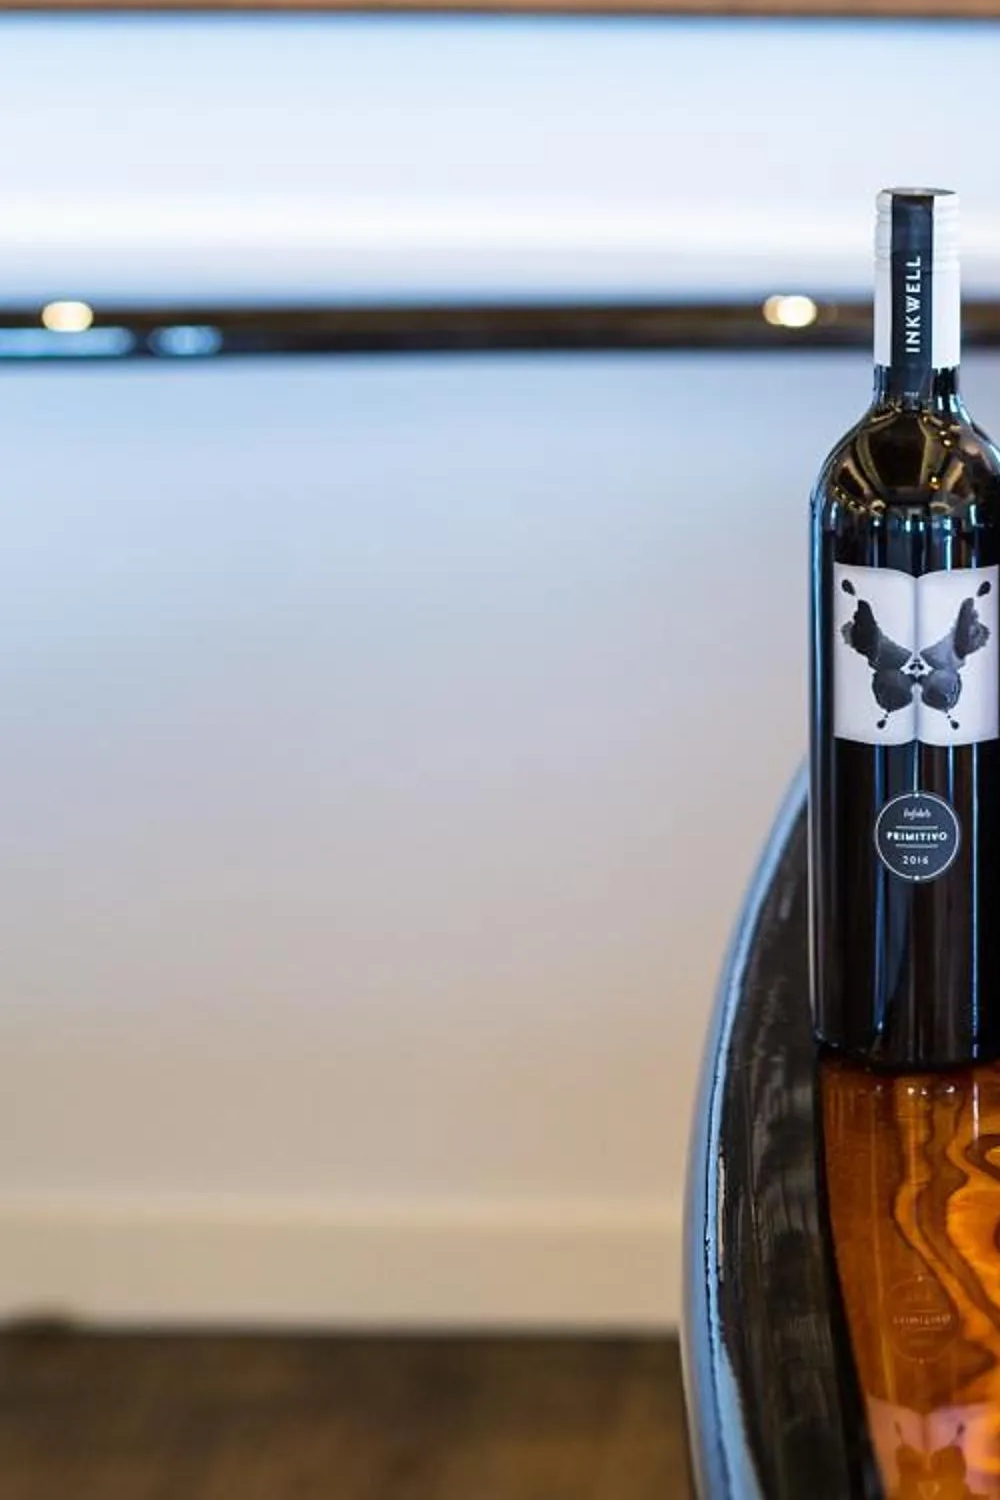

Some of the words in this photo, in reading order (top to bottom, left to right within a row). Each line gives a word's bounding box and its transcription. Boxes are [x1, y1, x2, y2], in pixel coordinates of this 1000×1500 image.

[905, 255, 922, 354] INKWELL
[886, 831, 948, 841] PRIMITIVO
[902, 855, 929, 865] 2016
